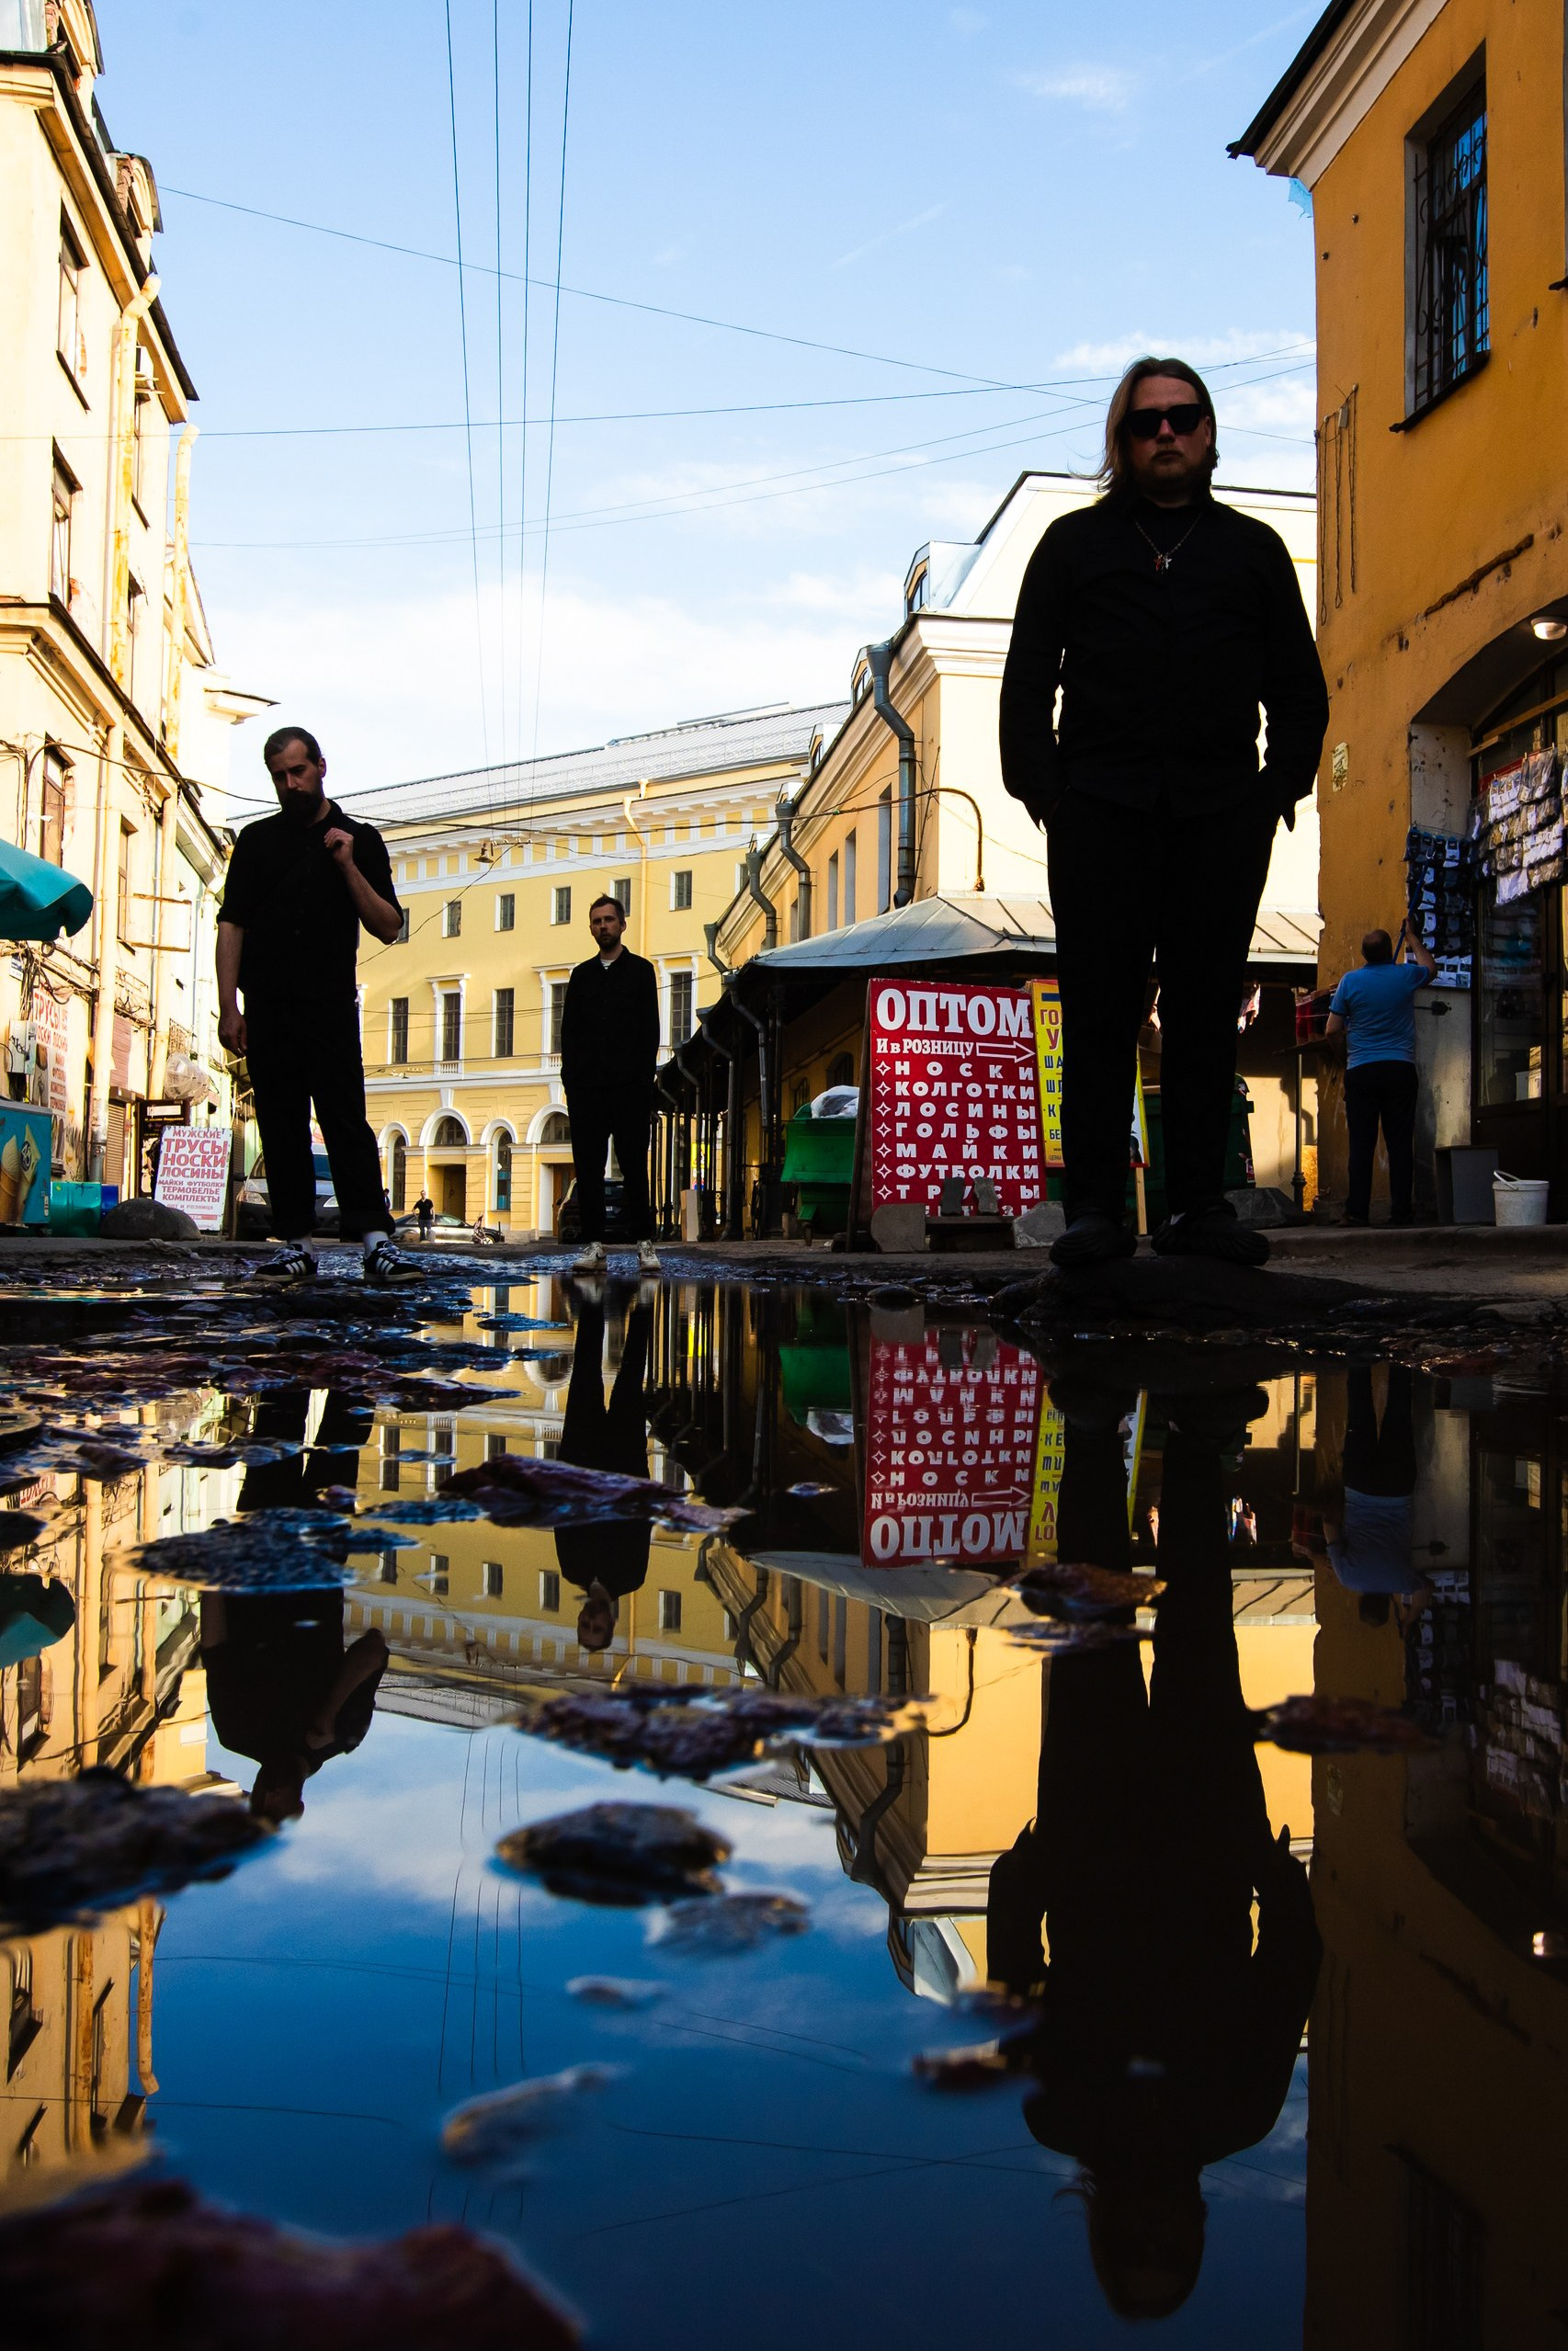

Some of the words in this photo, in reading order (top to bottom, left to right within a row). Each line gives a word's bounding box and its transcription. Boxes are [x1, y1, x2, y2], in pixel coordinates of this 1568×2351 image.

[35, 993, 60, 1028] ТРУСЫ
[876, 988, 1033, 1039] ОПТОМ
[1040, 1009, 1062, 1025] ГО
[38, 1026, 51, 1045] ОСКИ
[1046, 1028, 1060, 1050] У
[876, 1038, 888, 1054] И
[902, 1039, 973, 1058] РОЗНИЦУ
[1044, 1055, 1062, 1069] ША
[894, 1061, 1033, 1081] НОСКИ
[895, 1081, 1035, 1100] КОЛГОТКИ
[1046, 1080, 1062, 1093] ШЛ
[894, 1101, 1036, 1119] ЛОСИНЫ
[173, 1129, 221, 1139] МУЖСКИЕ
[895, 1122, 1037, 1140] ГОЛЬФЫ
[1050, 1129, 1062, 1140] БЕ
[165, 1139, 228, 1155] ТРУСЫ
[896, 1140, 1038, 1160] МАЙКИ
[163, 1153, 227, 1168] НОСКИ
[160, 1167, 224, 1179] ЛОСИНЫ
[895, 1164, 1040, 1179] ФУТБОЛКИ
[162, 1186, 220, 1195] ТЕРМОБЕЛЬЕ
[162, 1194, 220, 1203] КОМПЛЕКТЫ
